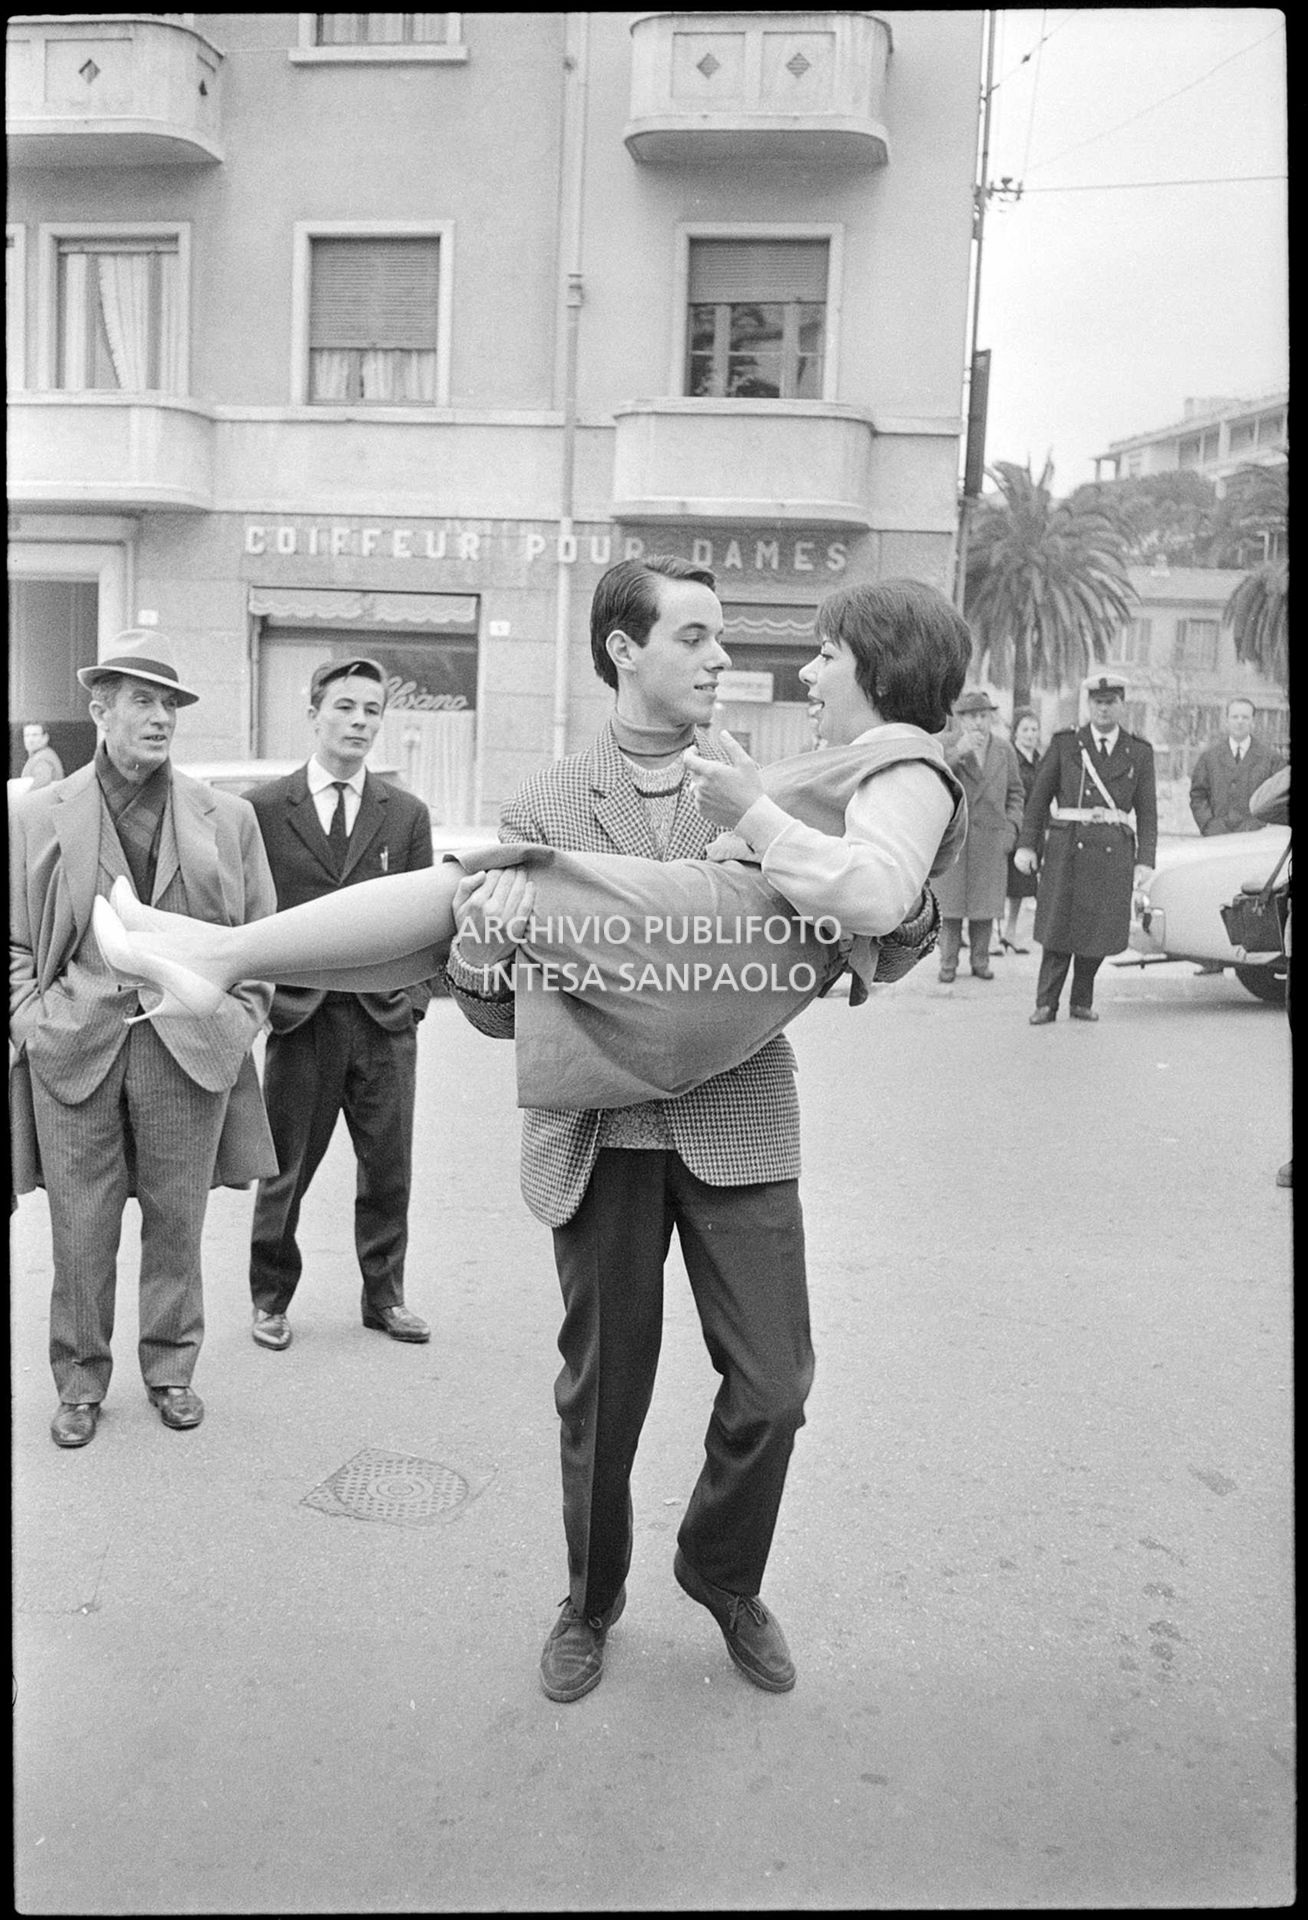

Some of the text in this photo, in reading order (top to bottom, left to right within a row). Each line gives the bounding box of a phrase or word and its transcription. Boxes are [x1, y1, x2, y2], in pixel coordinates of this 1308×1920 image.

[246, 525, 849, 571] COIFFEUR POUR DAMES
